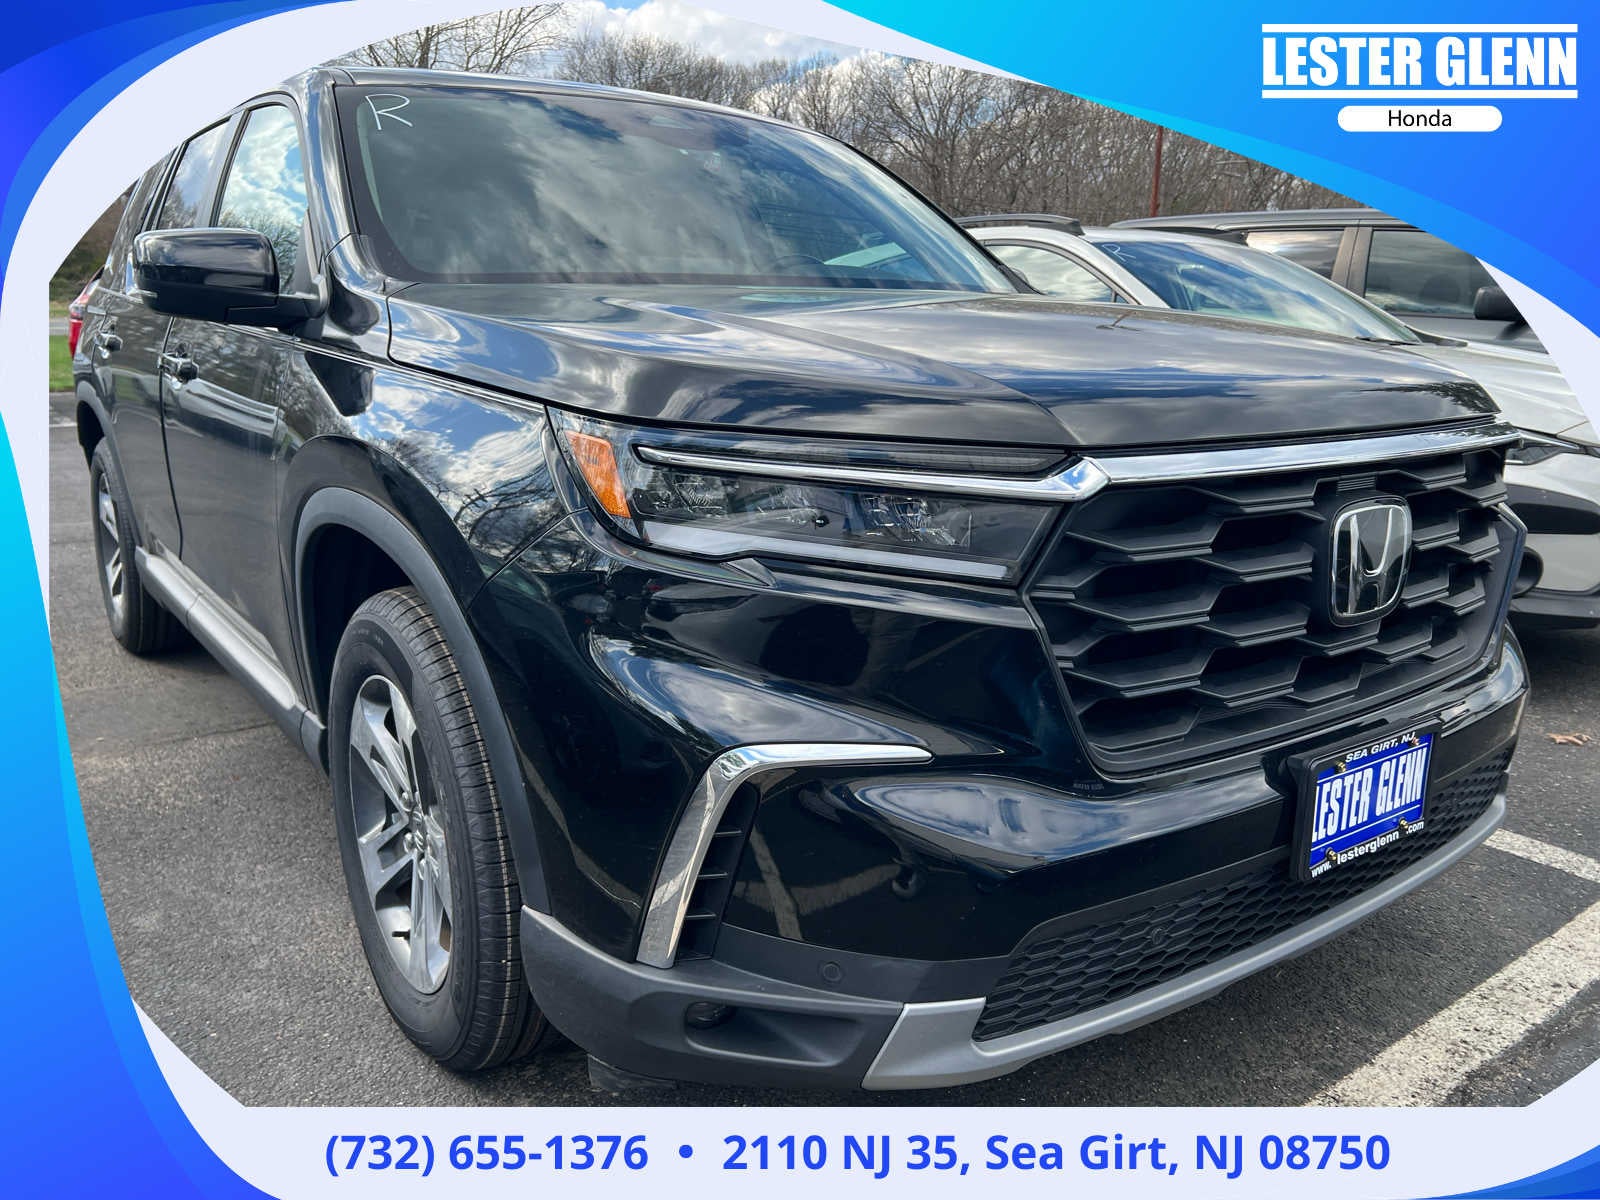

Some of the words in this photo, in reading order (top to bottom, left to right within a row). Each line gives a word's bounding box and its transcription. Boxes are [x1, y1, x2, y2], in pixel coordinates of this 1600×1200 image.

[365, 93, 413, 131] R
[1101, 243, 1137, 262] R
[1345, 748, 1368, 763] SEA
[1370, 738, 1399, 755] GIRT,
[1311, 767, 1373, 842] LESTER
[1375, 748, 1428, 816] GLENN
[1337, 831, 1400, 864] lesterglenn
